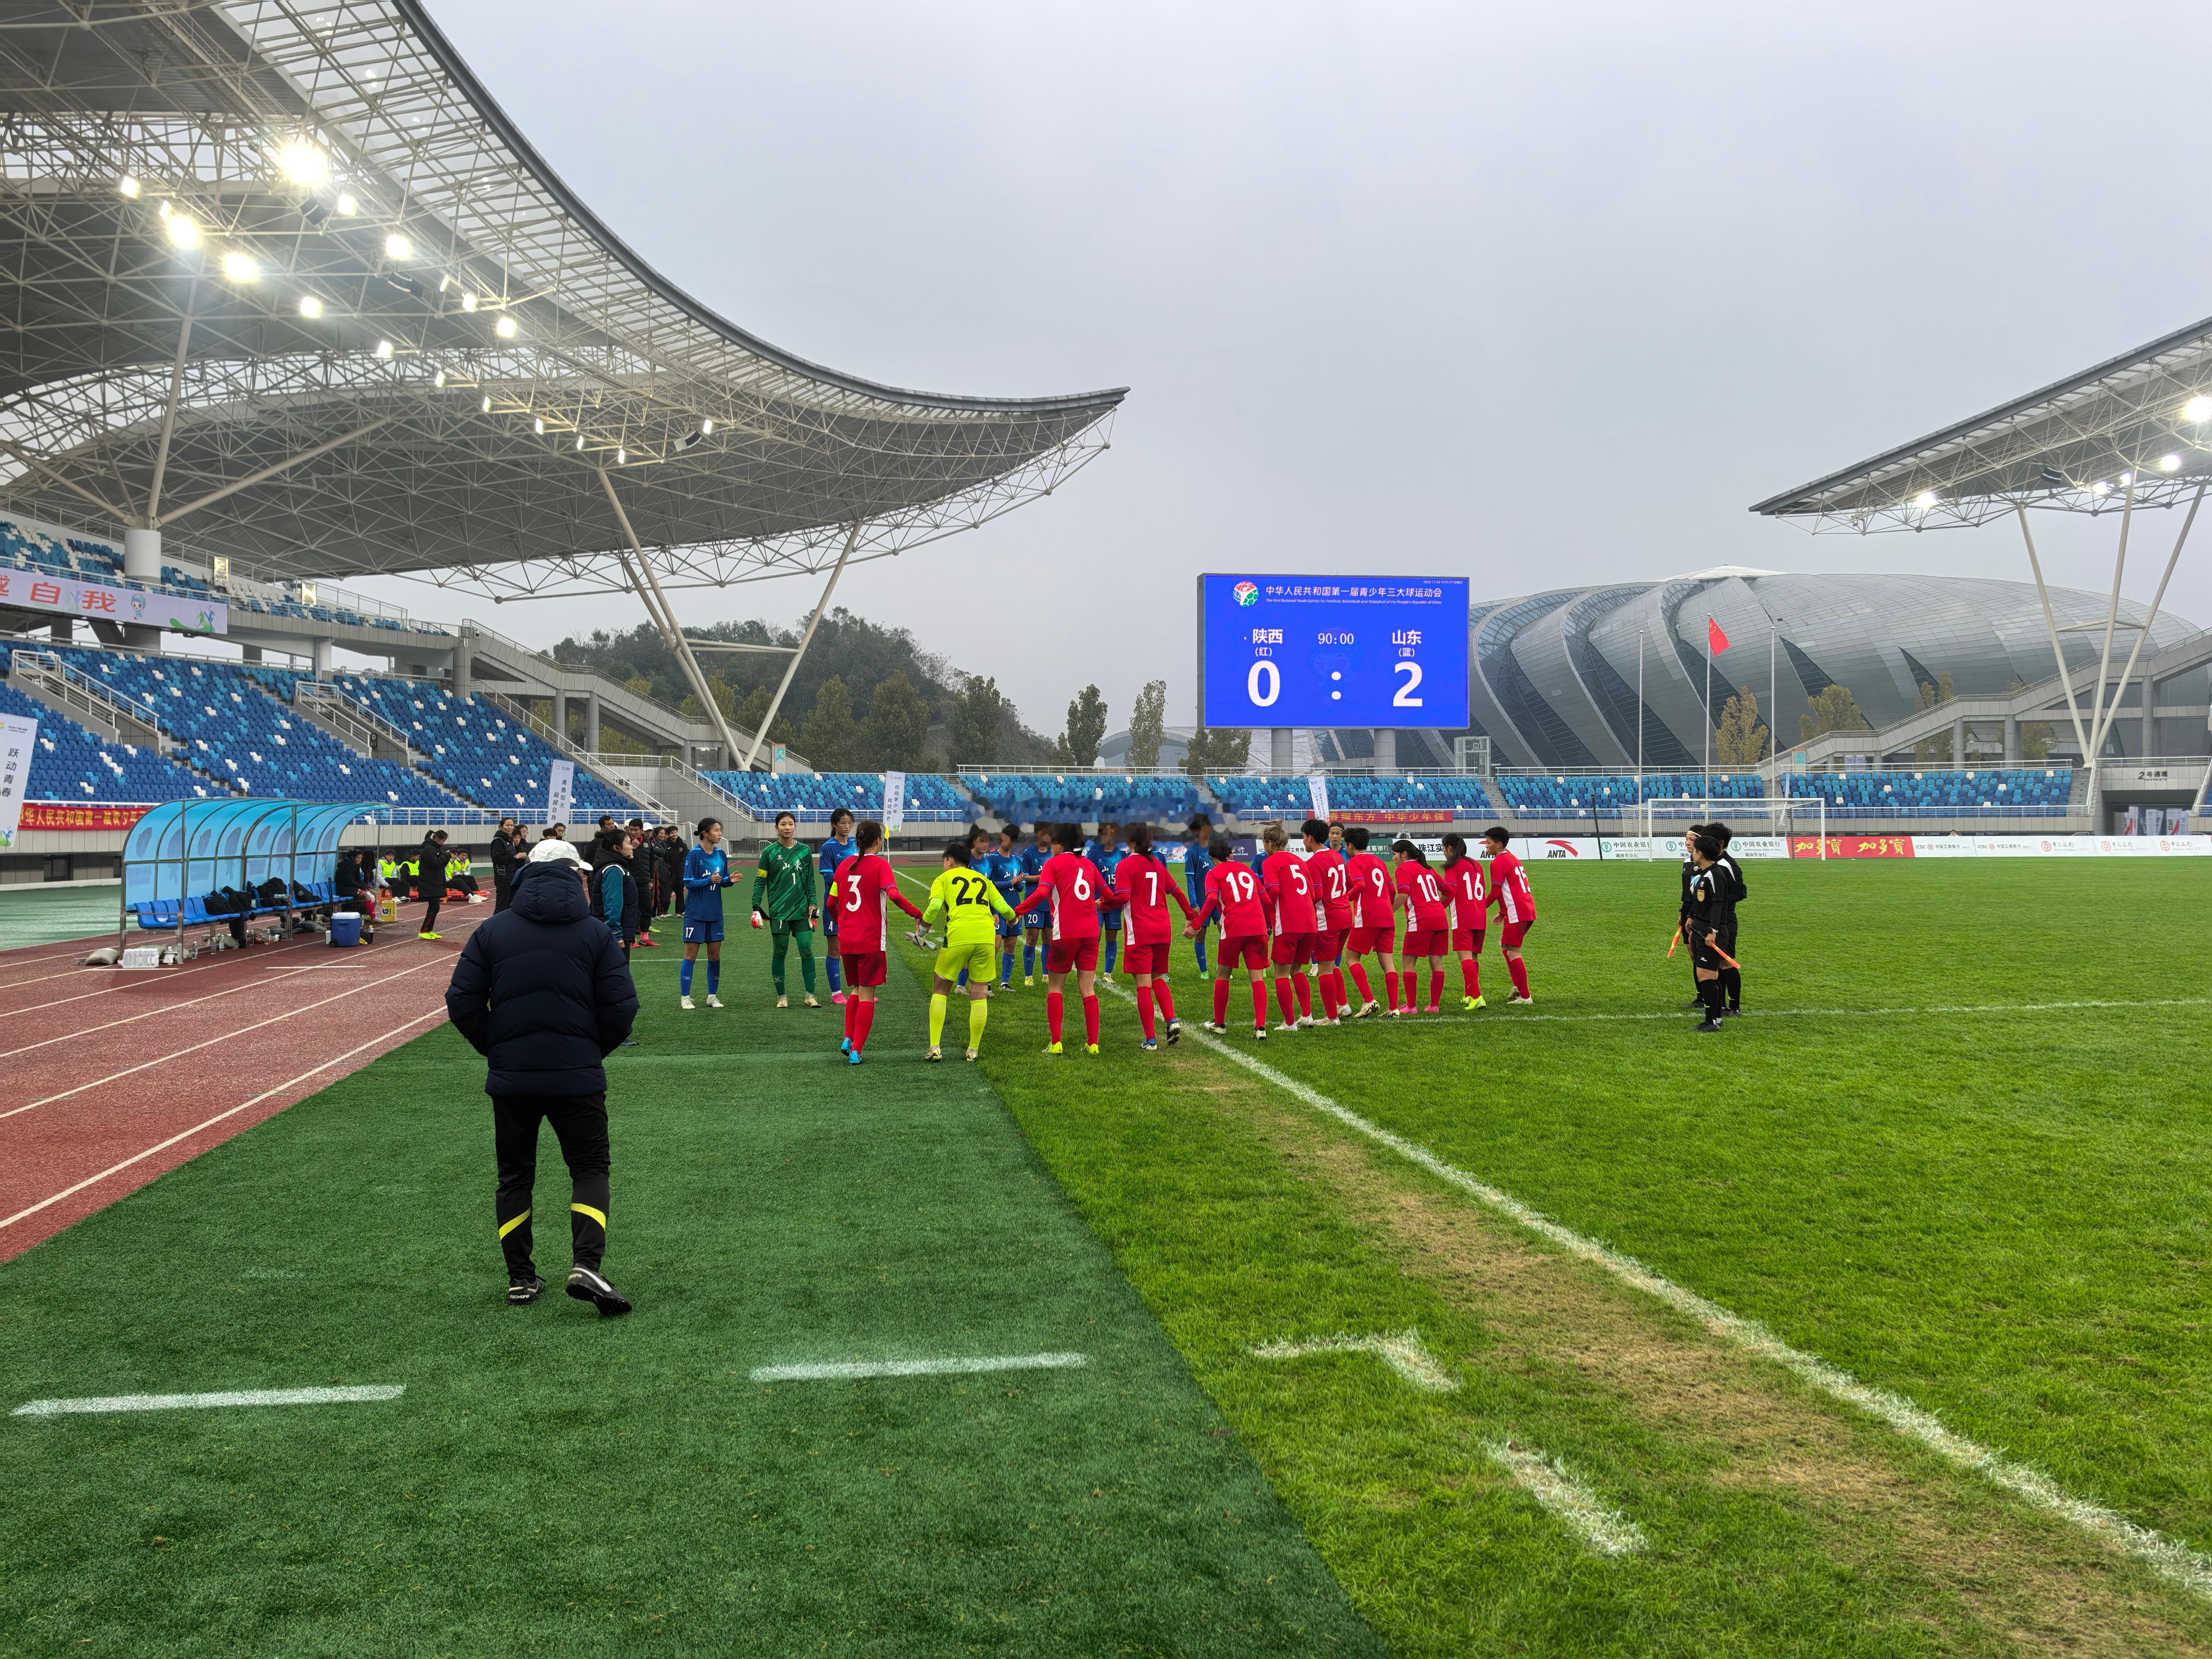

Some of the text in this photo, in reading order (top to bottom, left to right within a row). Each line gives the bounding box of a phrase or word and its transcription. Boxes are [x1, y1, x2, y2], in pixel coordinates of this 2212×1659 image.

[1266, 586, 1442, 597] 中华人民共和国第一届青少年三大球运动会
[1253, 629, 1283, 644] 陕西
[1318, 633, 1354, 645] 90:00
[1392, 630, 1422, 645] 山东
[1248, 660, 1280, 707] 0
[1393, 661, 1423, 707] 2
[2, 747, 20, 797] 跃动青春
[1384, 812, 1444, 821] 中华少年强
[792, 873, 796, 884] 1
[952, 877, 989, 907] 22
[1074, 867, 1090, 901] 6
[1146, 872, 1157, 906] 7
[1226, 871, 1254, 902] 19
[1289, 864, 1308, 895] 5
[1328, 864, 1346, 899] 27
[1371, 868, 1384, 897] 9
[1417, 874, 1440, 902] 10
[1463, 872, 1484, 901] 16
[846, 875, 861, 912] 3
[686, 927, 694, 938] 17
[828, 921, 833, 931] 4
[1028, 914, 1038, 924] 20
